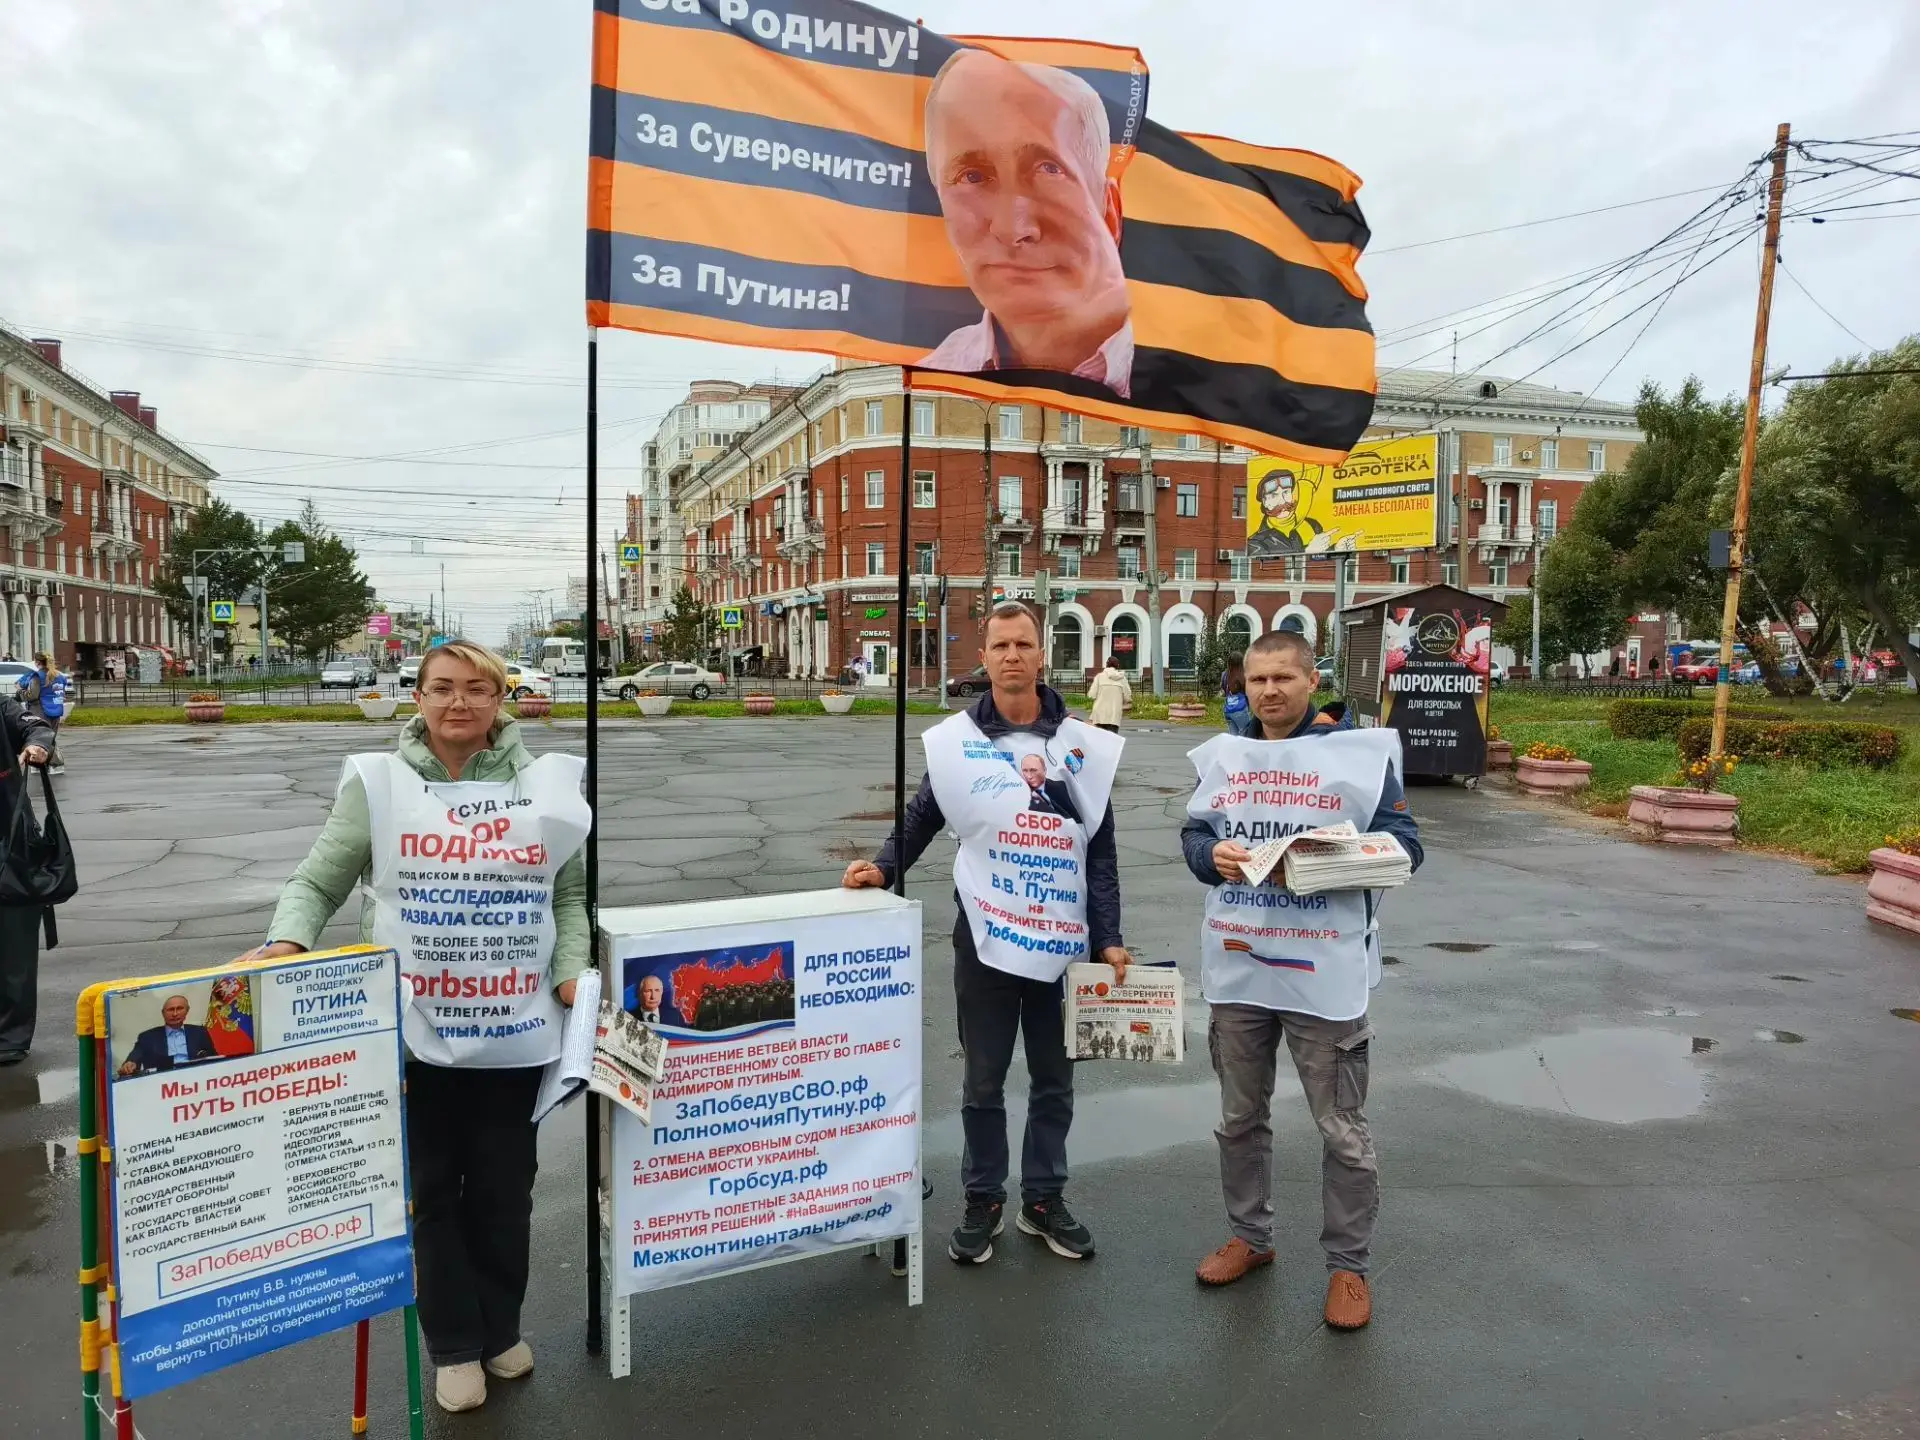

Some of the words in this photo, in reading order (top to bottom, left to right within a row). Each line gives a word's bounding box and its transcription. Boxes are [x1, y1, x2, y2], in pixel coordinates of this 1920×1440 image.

[720, 0, 919, 68] Родину!
[636, 114, 678, 148] За
[690, 121, 912, 188] Суверенитет!
[631, 254, 681, 290] За
[697, 262, 851, 312] Путина!
[1333, 459, 1430, 480] ФАРОТЕКА
[1381, 453, 1427, 463] АВТОСВЕТ
[1336, 489, 1363, 500] Лампы
[1365, 485, 1404, 497] головного
[1407, 482, 1429, 492] света
[1333, 503, 1370, 517] ЗАМЕНА
[1373, 498, 1429, 513] БЕСПЛАТНО
[1389, 674, 1483, 693] МОРОЖЕНОЕ
[1408, 700, 1423, 709] ДЛЯ
[1424, 700, 1462, 709] ВЗРОСЛЫХ
[1429, 729, 1459, 737] РАБОТЫ:
[1227, 770, 1319, 788] НАРОДНЫЙ
[1211, 791, 1247, 809] СБОР
[1254, 790, 1341, 810] ПОДПИСЕЙ
[1016, 813, 1062, 831] СБОР
[999, 831, 1073, 851] ПОДПИСЕЙ
[989, 849, 996, 859] в
[1002, 851, 1078, 875] поддержку
[399, 871, 416, 880] ПОД
[420, 871, 459, 880] ИСКОМ
[463, 872, 470, 880] В
[474, 873, 529, 883] ВЕРХОВНЫЙ
[530, 875, 544, 884] СУД
[992, 873, 1018, 896] В.В.
[1026, 882, 1077, 903] Путина
[1020, 870, 1055, 883] КУРСА
[399, 888, 409, 900] О
[401, 912, 466, 926] РАЗВАЛА
[471, 912, 513, 926] СССР
[518, 912, 526, 925] В
[1029, 904, 1044, 913] на
[411, 935, 429, 947] УЖЕ
[433, 937, 478, 947] БОЛЕЕ
[483, 936, 503, 946] 500
[507, 934, 538, 946] ТЫСЯЧ
[412, 950, 465, 962] ЧЕЛОВЕК
[470, 951, 486, 961] ИЗ
[491, 951, 504, 960] 60
[507, 949, 537, 960] СТРАН
[804, 955, 837, 972] ДЛЯ
[842, 945, 910, 965] ПОБЕДЫ
[276, 970, 311, 984] СБОР
[316, 957, 383, 979] ПОДПИСЕЙ
[826, 966, 891, 987] РОССИИ
[306, 977, 363, 992] ПОДДЕРЖКУ
[801, 982, 915, 1009] НЕОБХОДИМО:
[1111, 990, 1175, 998] СУВЕРЕНИТЕТ
[293, 989, 367, 1015] ПУТИНА
[435, 1006, 515, 1018] ТЕЛЕГРАМ:
[284, 1019, 378, 1041] Владимировича
[298, 1008, 363, 1026] Владимира
[747, 1038, 797, 1057] ВЕТВЕЙ
[801, 1033, 849, 1050] ВЛАСТИ
[783, 1049, 829, 1067] СОВЕТУ
[834, 1046, 851, 1058] ВО
[854, 1041, 891, 1055] ГЛАВЕ
[894, 1038, 901, 1049] С
[161, 1081, 198, 1099] Мы
[206, 1050, 356, 1091] поддерживаем
[738, 1068, 804, 1088] ПУТИНЫМ.
[173, 1097, 235, 1123] ПУТЬ
[243, 1073, 348, 1107] ПОБЕДЫ:
[289, 1102, 331, 1116] ВЕРНУТЬ
[334, 1090, 384, 1106] ПОЛЁТНЫЕ
[676, 1075, 869, 1121] ЗаПобедувСВО.рф
[283, 1111, 327, 1127] ЗАДАНИЯ
[340, 1103, 366, 1114] НАШЕ
[369, 1099, 388, 1108] СЯО
[290, 1113, 380, 1139] ГОСУДАРСТВЕННАЯ
[654, 1093, 887, 1145] ПолномочияПутину.рф
[130, 1137, 172, 1153] ОТМЕНА
[175, 1116, 264, 1141] НЕЗАВИСИМОСТИ
[284, 1131, 341, 1150] ИДЕОЛОГИЯ
[634, 1161, 644, 1170] 2.
[648, 1151, 705, 1169] ОТМЕНА
[709, 1136, 792, 1159] ВЕРХОВНЫМ
[795, 1128, 837, 1145] СУДОМ
[840, 1111, 917, 1137] НЕЗАКОННОЙ
[126, 1146, 174, 1164] УКРАИНЫ
[130, 1161, 170, 1178] СТАВКА
[173, 1144, 241, 1166] ВЕРХОВНОГО
[285, 1139, 353, 1159] ПАТРИОТИЗМА
[285, 1153, 327, 1171] (ОТМЕНА
[330, 1145, 364, 1158] СТАТЬИ
[368, 1141, 376, 1149] 13
[379, 1138, 395, 1147] П.2)
[124, 1151, 254, 1190] ГЛАВНОКОМАНДУЮЩЕГО
[293, 1159, 366, 1183] ВЕРХОВЕНСТВО
[634, 1157, 753, 1186] НЕЗАВИСИМОСТИ
[757, 1147, 819, 1164] УКРАИНЫ.
[710, 1160, 828, 1196] Горбсуд.рф
[131, 1171, 235, 1205] ГОСУДАРСТВЕННЫЙ
[287, 1171, 356, 1194] РОССИЙСКОГО
[288, 1174, 384, 1204] ЗАКОНОДАТЕЛЬСТВА
[125, 1198, 172, 1217] КОМИТЕТ
[176, 1184, 228, 1202] ОБОРОНЫ
[132, 1197, 236, 1231] ГОСУДАРСТВЕННЫЙ
[239, 1188, 271, 1202] СОВЕТ
[288, 1199, 330, 1214] (ОТМЕНА
[333, 1188, 367, 1201] СТАТЬИ
[370, 1184, 379, 1192] 15
[381, 1180, 398, 1189] П.4)
[634, 1220, 644, 1231] 3.
[648, 1211, 710, 1229] ВЕРНУТЬ
[715, 1195, 786, 1216] ПОЛЕТНЫЕ
[789, 1183, 847, 1204] ЗАДАНИЯ
[852, 1180, 869, 1192] ПО
[873, 1170, 916, 1189] ЦЕНТРУ
[126, 1232, 145, 1244] КАК
[148, 1220, 189, 1237] ВЛАСТЬ
[195, 1206, 241, 1224] ВЛАСТЕЙ
[634, 1225, 707, 1245] ПРИНЯТИЯ
[711, 1210, 775, 1232] РЕШЕНИЙ
[786, 1195, 872, 1220] #НаВашингтон
[133, 1222, 237, 1257] ГОСУДАРСТВЕННЫЙ
[241, 1214, 266, 1227] БАНК
[634, 1201, 893, 1268] Межконтинентальные.рф
[172, 1215, 362, 1282] ЗаПобедувСВО.рф
[217, 1289, 260, 1307] Путину
[263, 1279, 287, 1294] В.В.
[290, 1267, 327, 1285] нужны
[182, 1294, 286, 1335] дополнительные
[288, 1272, 359, 1300] полномочия,
[132, 1344, 173, 1364] чтобы
[176, 1325, 238, 1350] закончить
[242, 1289, 342, 1327] конституционную
[345, 1274, 395, 1298] реформу
[398, 1271, 404, 1280] и
[157, 1348, 206, 1372] вернуть
[211, 1326, 268, 1352] ПОЛНЫЙ
[271, 1305, 342, 1333] суверенитет
[345, 1291, 386, 1310] России.
